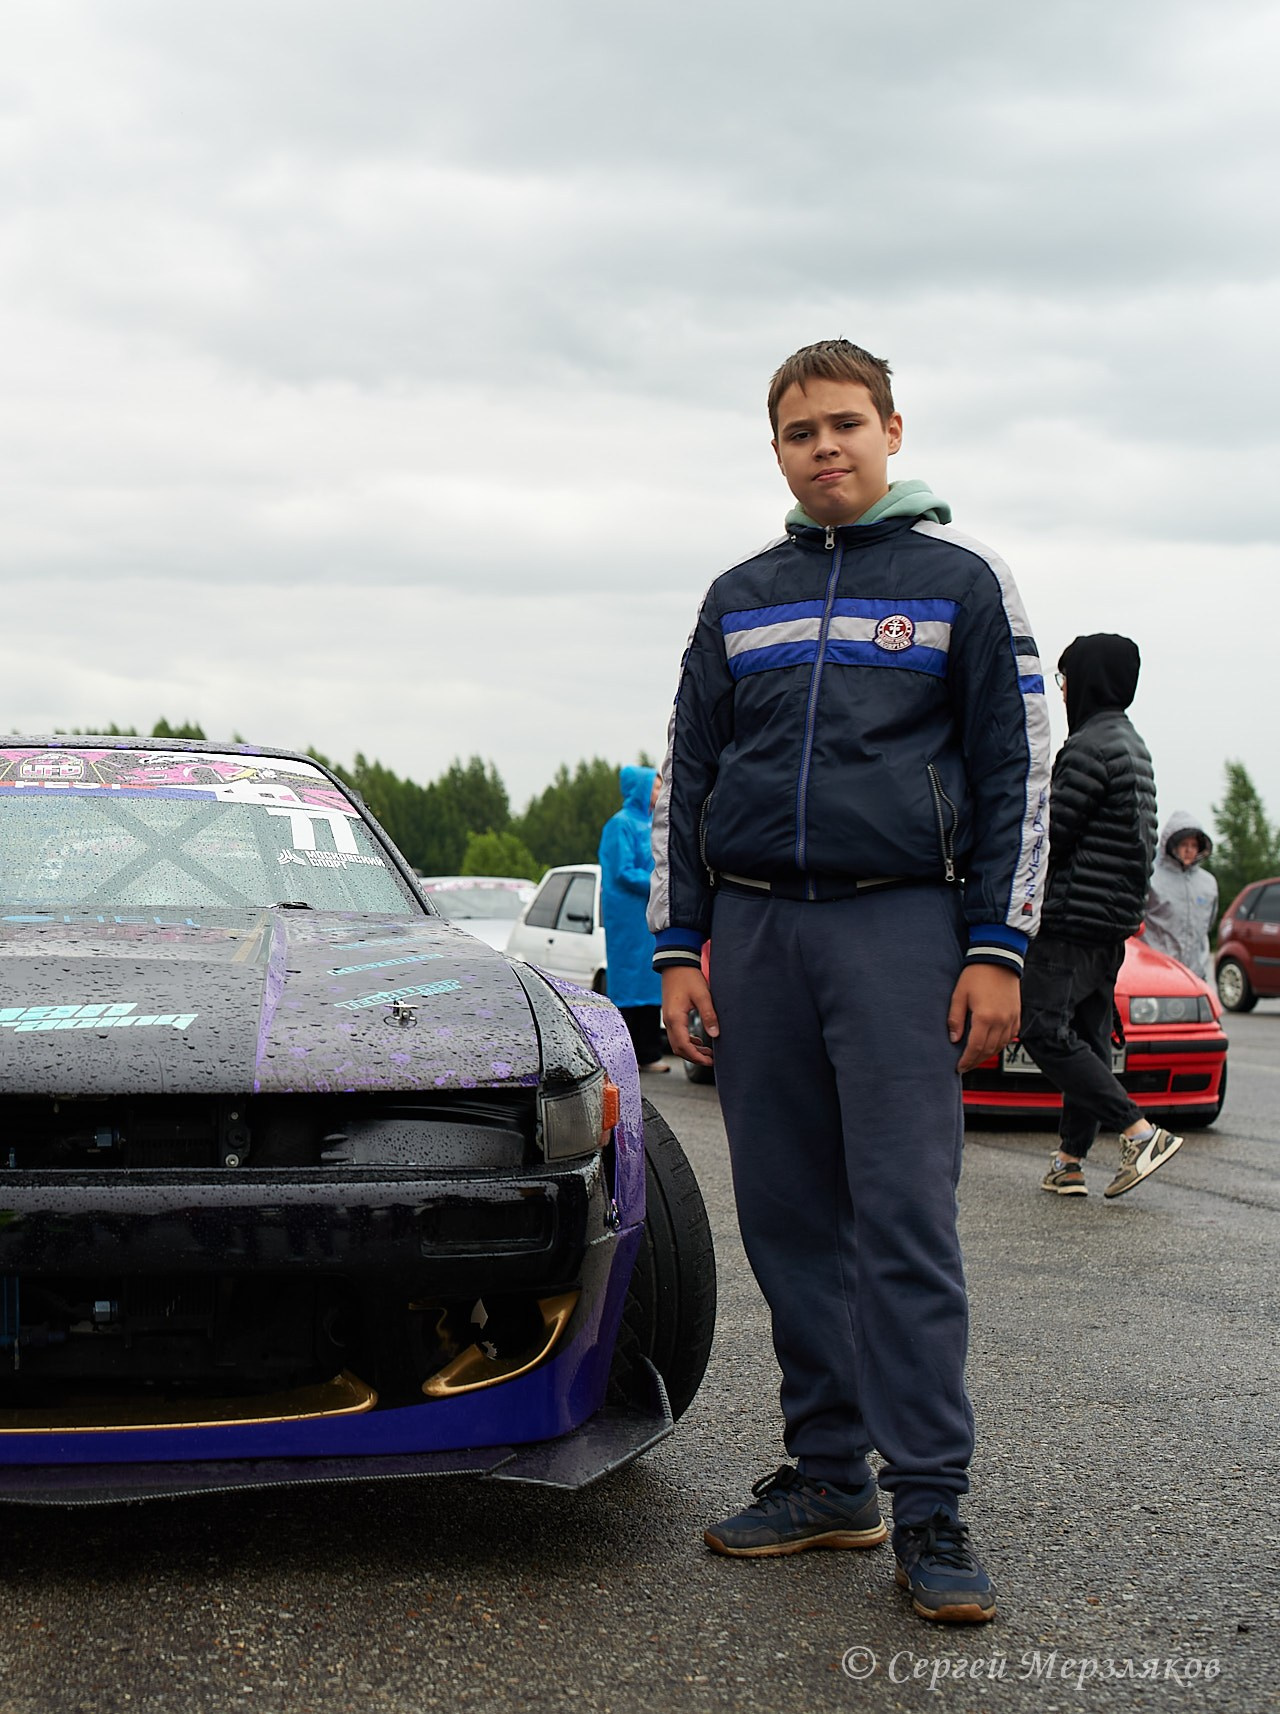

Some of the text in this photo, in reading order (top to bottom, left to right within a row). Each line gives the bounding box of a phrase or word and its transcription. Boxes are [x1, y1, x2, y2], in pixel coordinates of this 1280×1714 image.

[266, 807, 360, 855] 77
[304, 850, 386, 868] МОСКОВСКИЙ
[309, 858, 348, 870] СПОРТ
